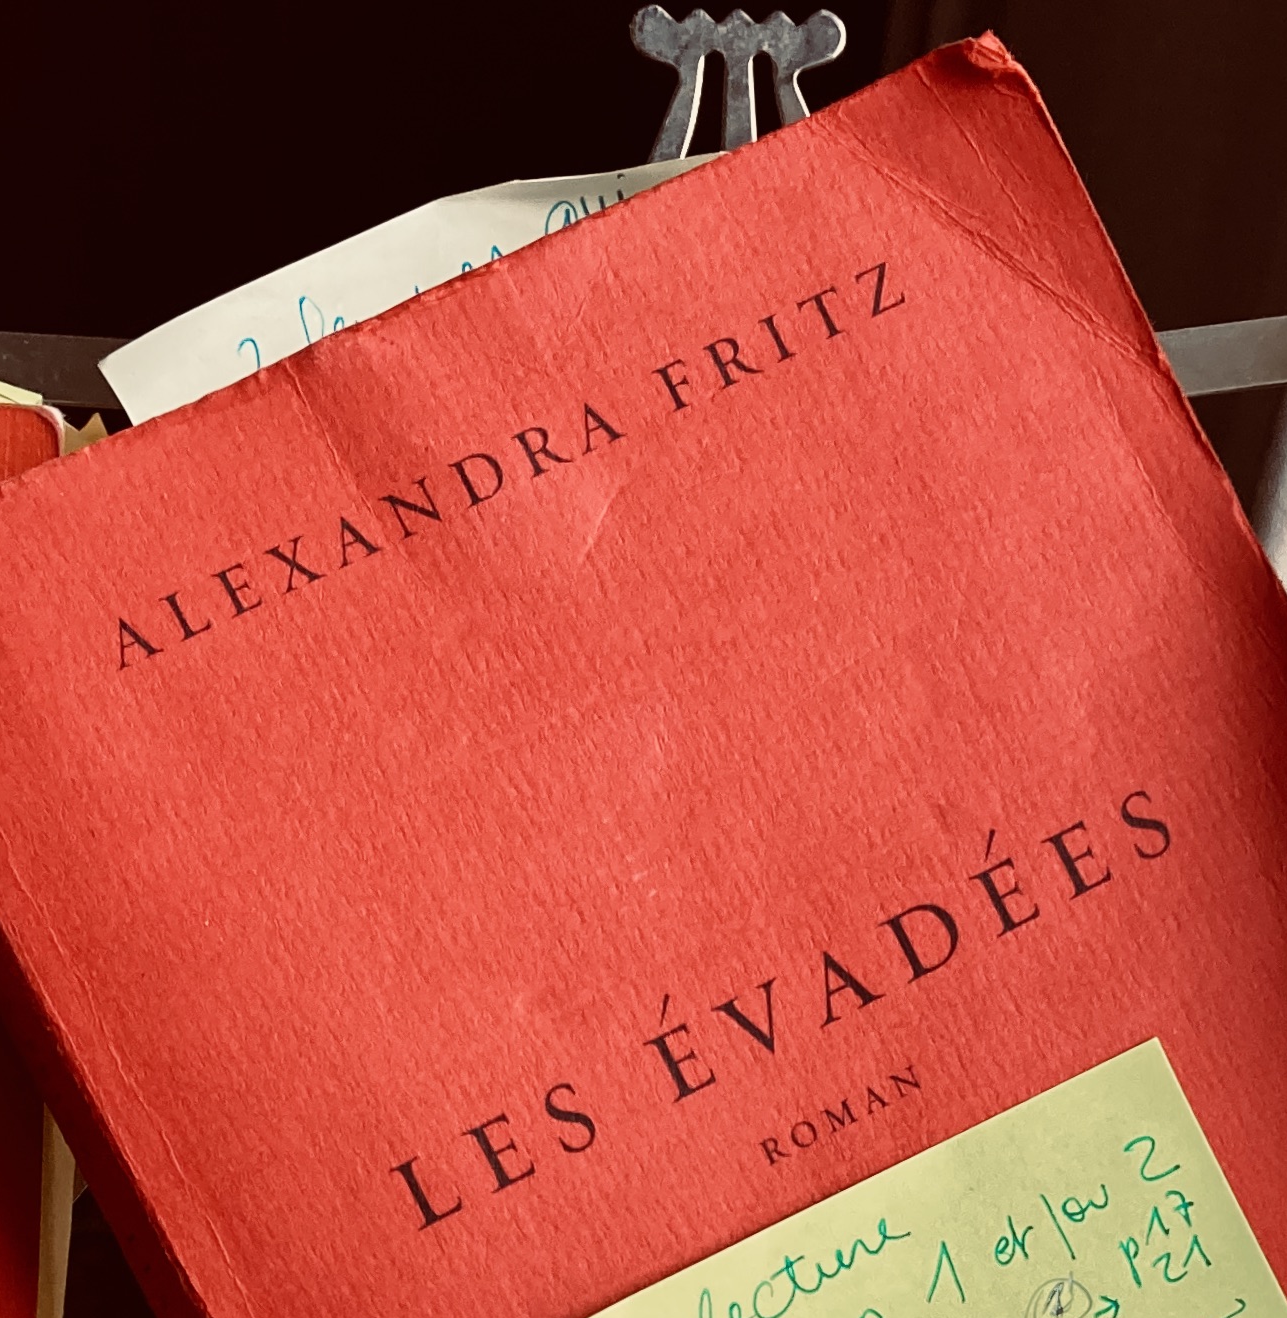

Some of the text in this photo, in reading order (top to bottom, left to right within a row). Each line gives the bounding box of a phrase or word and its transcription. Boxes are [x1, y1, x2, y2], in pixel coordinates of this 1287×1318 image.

[117, 401, 625, 671] ALEXANDRA
[651, 261, 906, 411] FRITZ
[389, 789, 1173, 1230] LES ÉVADÉES
[758, 1064, 923, 1166] ROMAN
[927, 1240, 966, 1303] 1
[1124, 1135, 1180, 1181] 2
[1152, 1234, 1212, 1283] 21
